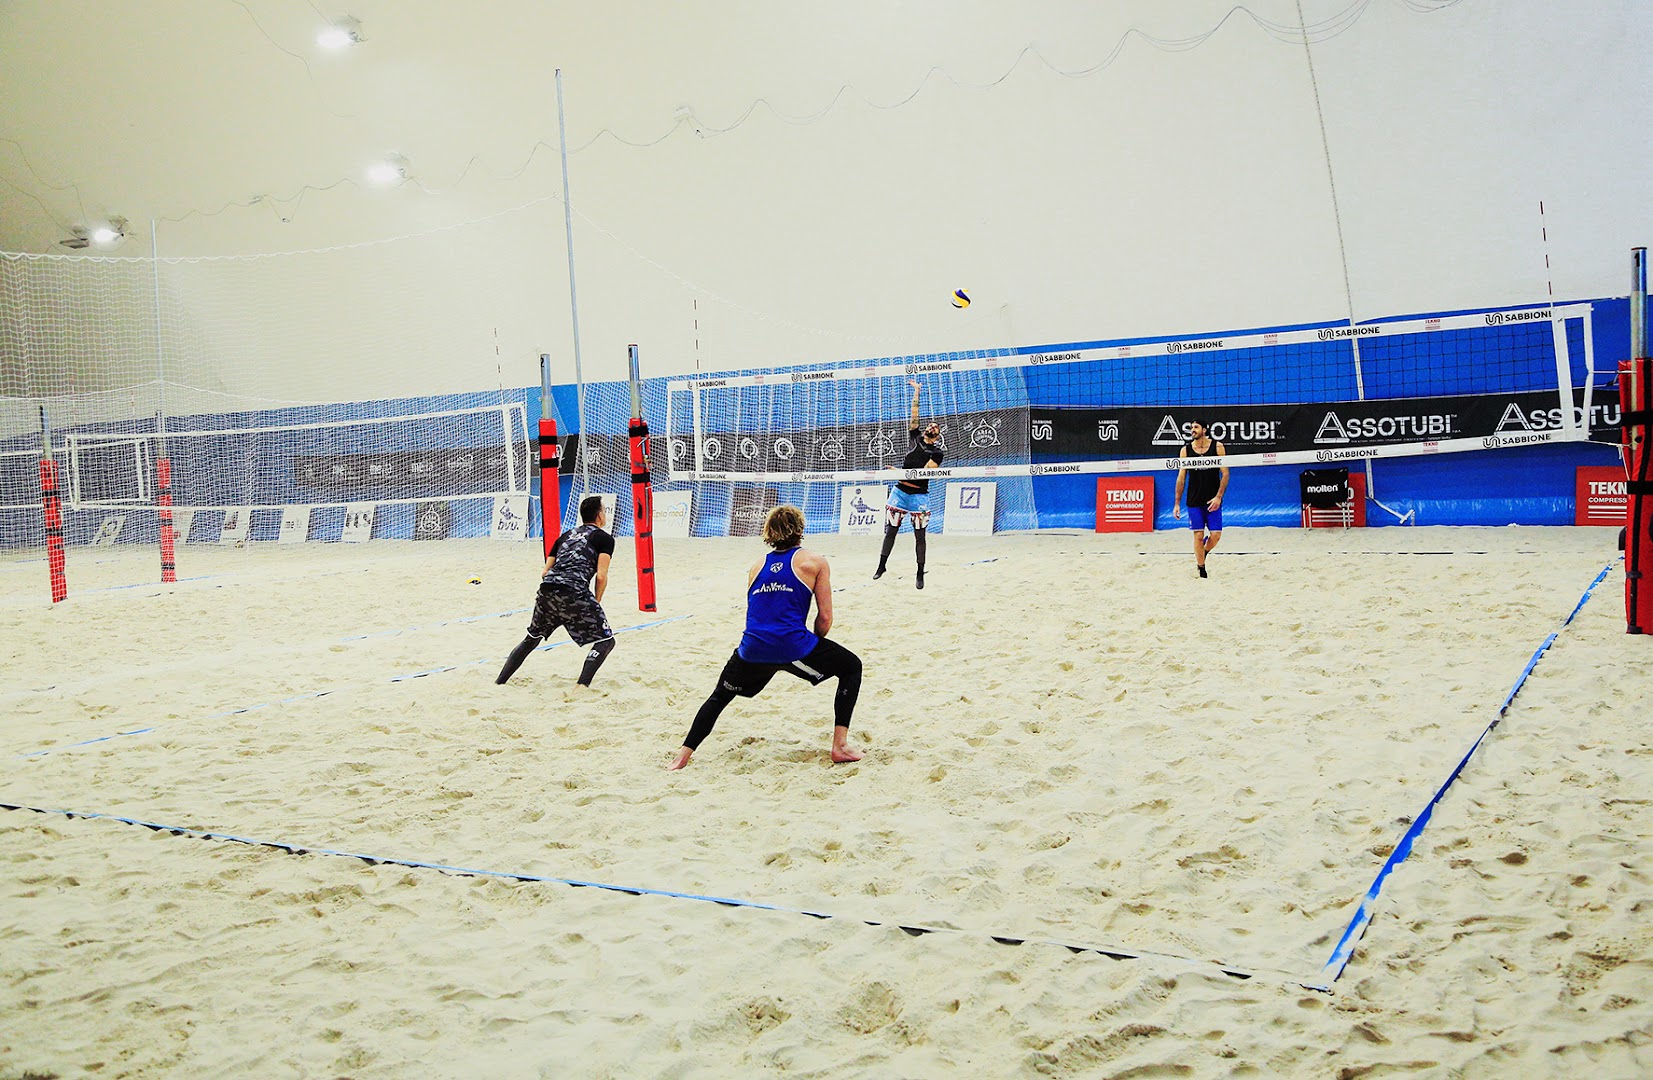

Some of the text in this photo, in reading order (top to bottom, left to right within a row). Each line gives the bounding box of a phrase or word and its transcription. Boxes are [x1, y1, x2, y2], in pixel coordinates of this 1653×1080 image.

[1335, 327, 1380, 337] SABBIONE
[1183, 340, 1223, 350] SABBIONE
[1044, 353, 1081, 362] SABBIONE
[919, 363, 952, 373] SABBIONE
[803, 372, 834, 380] SABBIONE
[698, 380, 727, 388] SABBIONE
[1151, 415, 1276, 446] ASOTUBI
[1313, 411, 1451, 444] ASSOTUBI
[1502, 433, 1551, 445] SABBIONE
[1334, 449, 1378, 459] SABBIONE
[1182, 459, 1222, 467] SABBIONE
[918, 469, 952, 477] SABBIONE
[1044, 465, 1080, 473] SABBIONE
[1307, 484, 1338, 493] molten
[1588, 481, 1628, 495] TEKN
[1106, 489, 1144, 502] TEKNO
